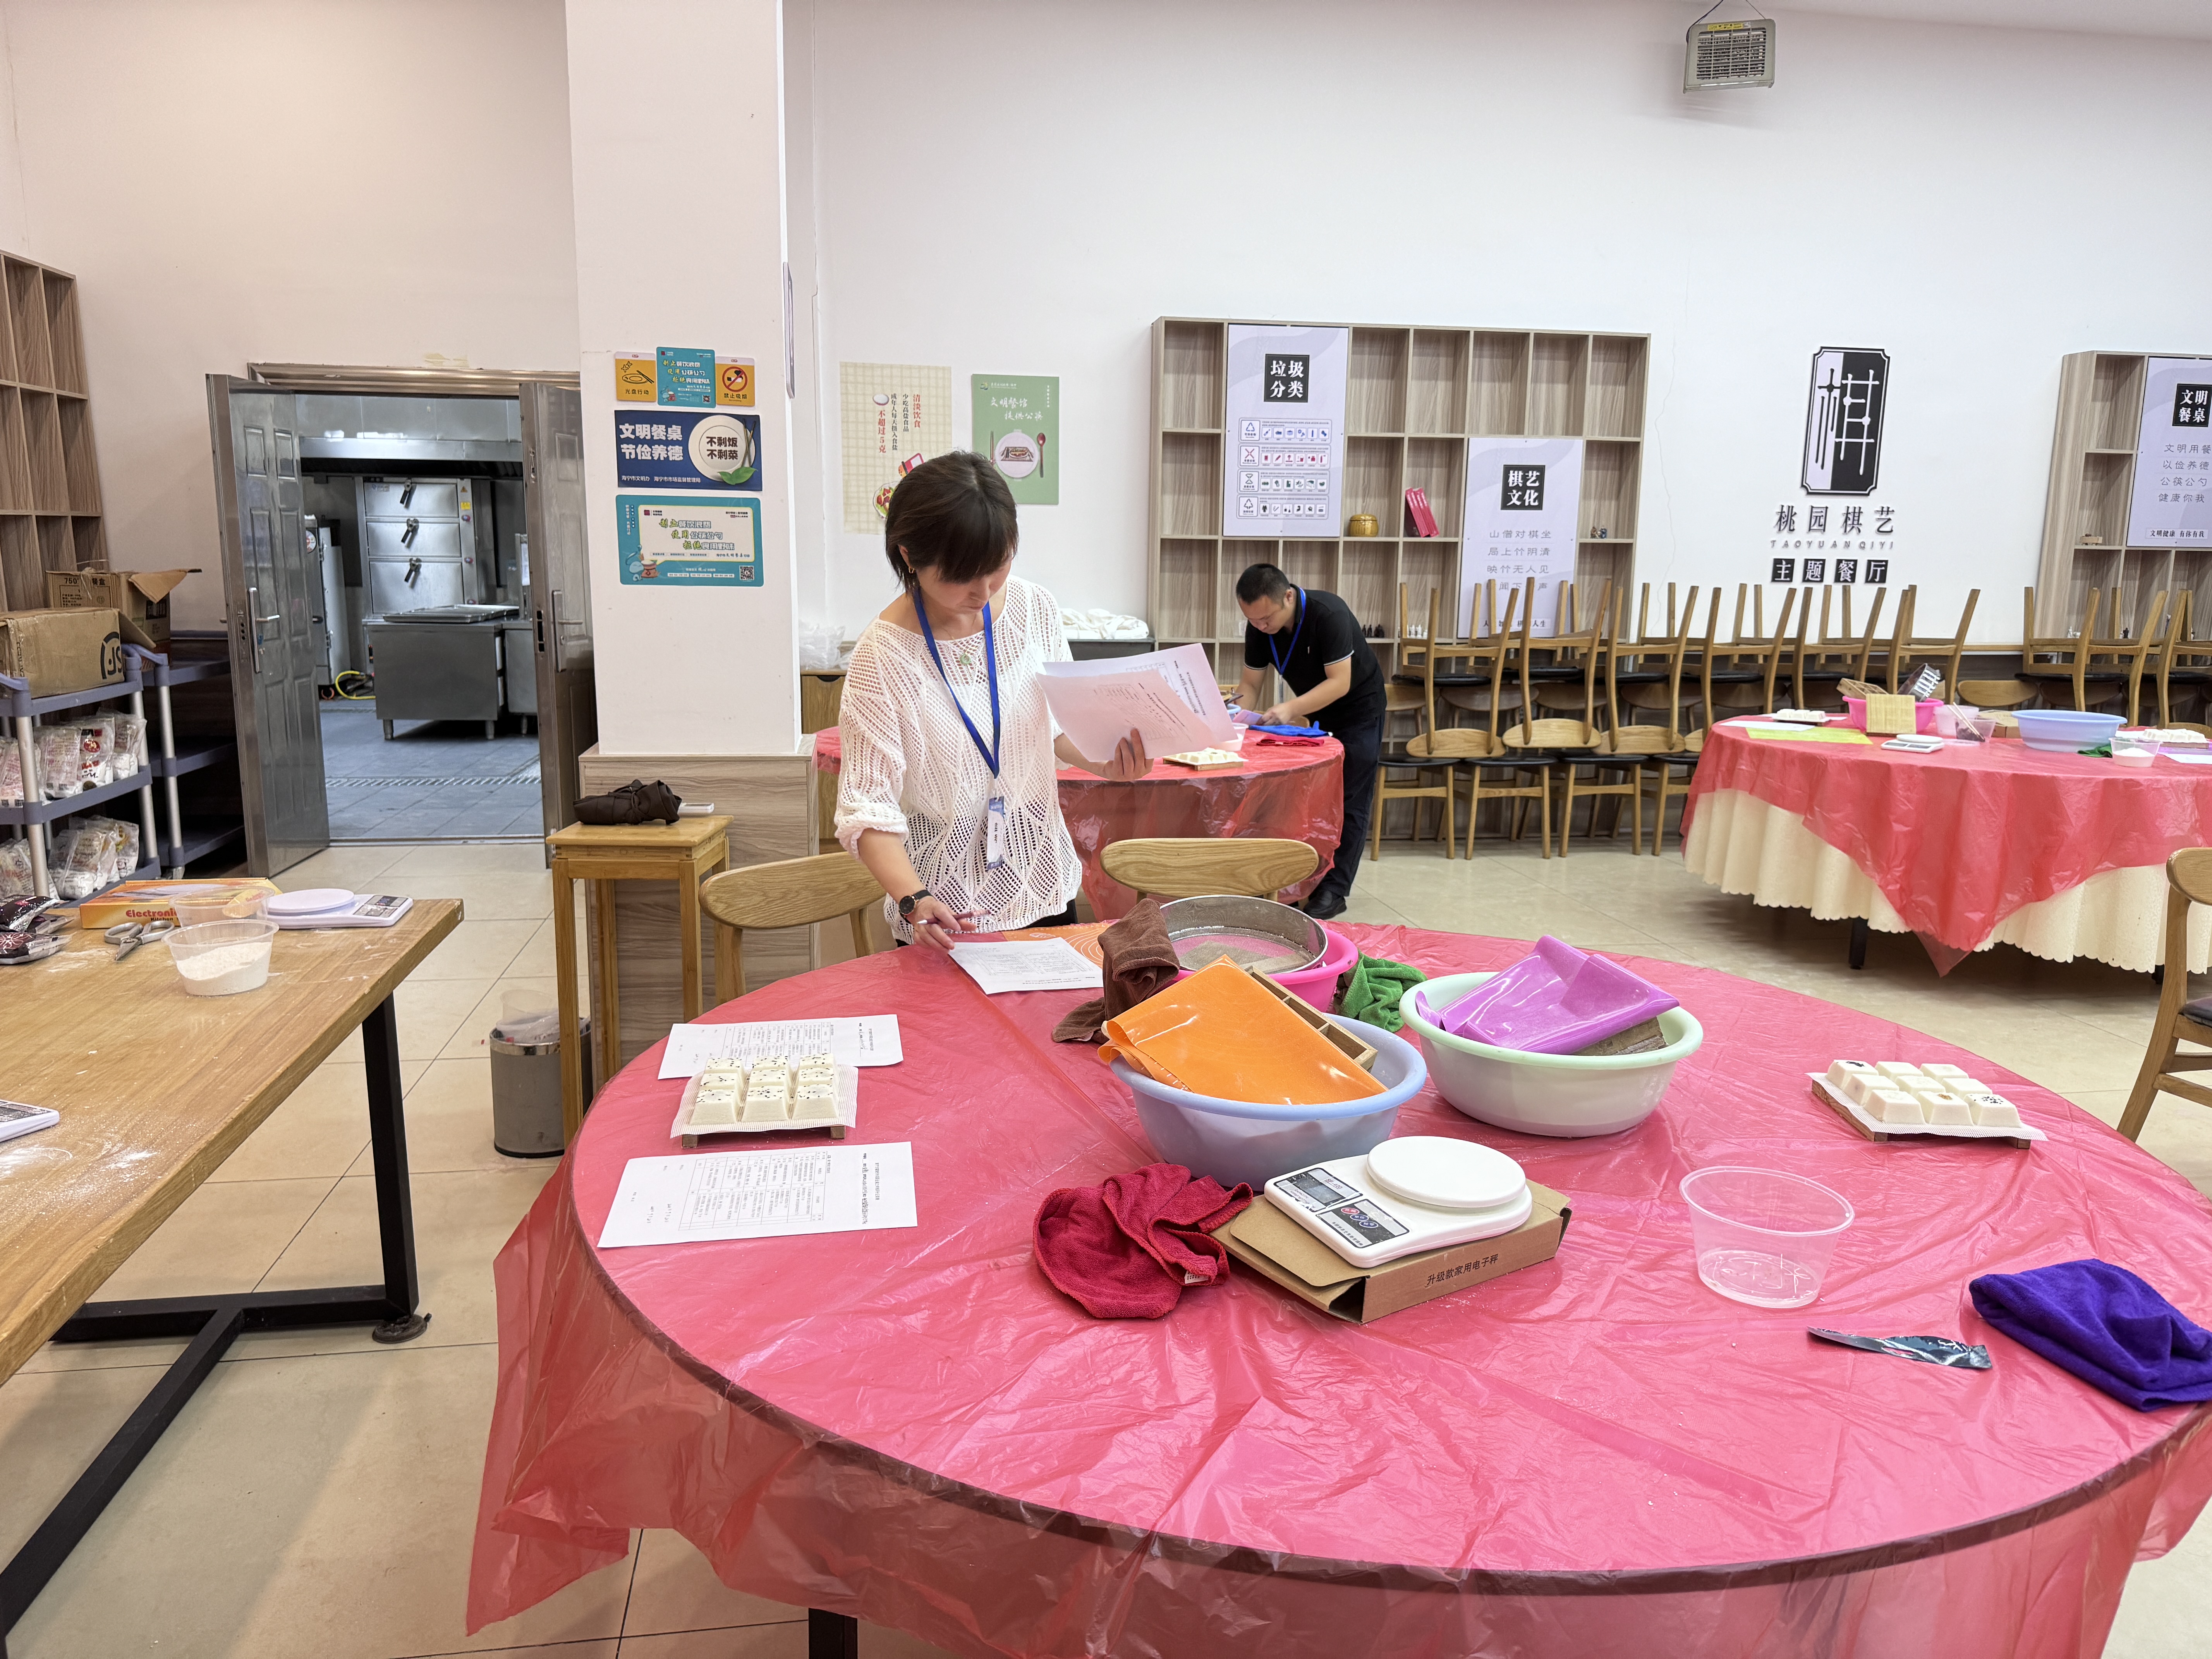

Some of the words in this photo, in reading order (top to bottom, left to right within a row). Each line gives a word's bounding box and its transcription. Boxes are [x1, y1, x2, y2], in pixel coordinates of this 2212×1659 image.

[1270, 360, 1304, 378] 垃圾
[1270, 380, 1303, 398] 分类
[2180, 390, 2208, 405] 文明
[2179, 407, 2205, 423] 餐桌
[619, 423, 682, 441] 文明餐桌
[706, 436, 738, 448] 不剩饭
[620, 444, 684, 461] 节俭养德
[707, 449, 738, 460] 不剩菜
[2164, 443, 2211, 454] 文明用餐
[2163, 460, 2209, 470] 以俭养德
[1508, 470, 1540, 487] 棋艺
[2160, 477, 2207, 486] 公筷公勺
[1506, 489, 1539, 506] 文化
[2158, 493, 2204, 503] 健康你我
[659, 518, 711, 528] 制止餐饮浪费
[1774, 504, 1895, 534] 桃园棋艺
[671, 529, 723, 539] 使用公筷公勺
[1490, 530, 1551, 539] 山僧对棋坐
[683, 540, 735, 550] 拒绝食用野味
[1488, 547, 1550, 556] 局上竹阴清
[1487, 565, 1549, 574] 映竹无人见
[1774, 560, 1886, 582] 主题餐厅
[1427, 1254, 1498, 1285] 升级款家用电子秤
